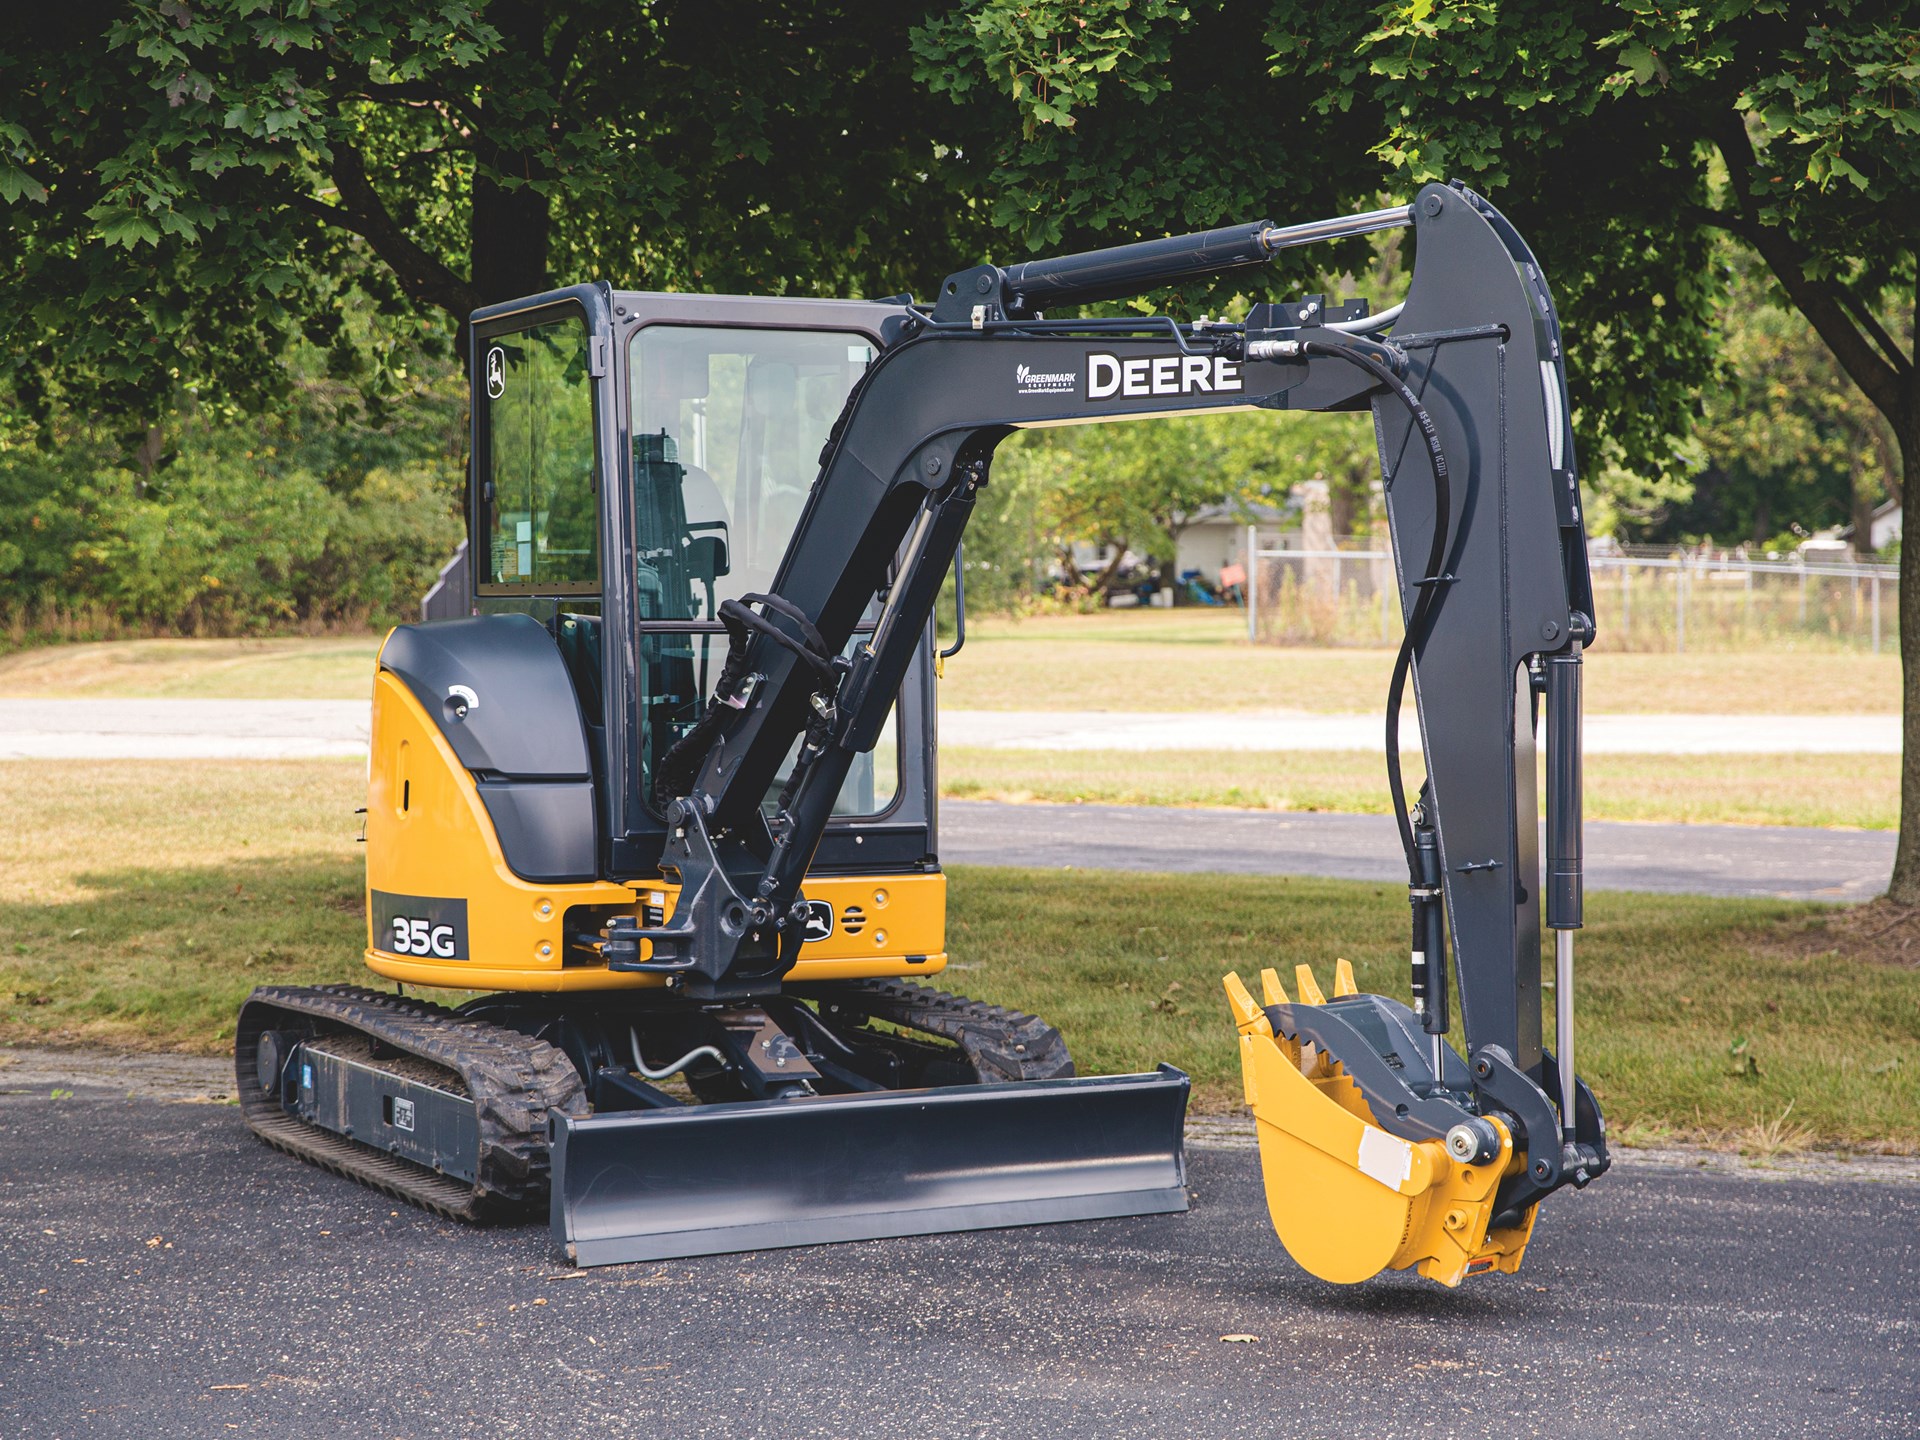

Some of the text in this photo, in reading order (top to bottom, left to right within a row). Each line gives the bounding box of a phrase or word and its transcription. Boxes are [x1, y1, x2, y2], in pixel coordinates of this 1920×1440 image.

[1024, 373, 1076, 383] GREENMARK
[1088, 354, 1242, 398] DEERE
[392, 917, 455, 957] 35G
